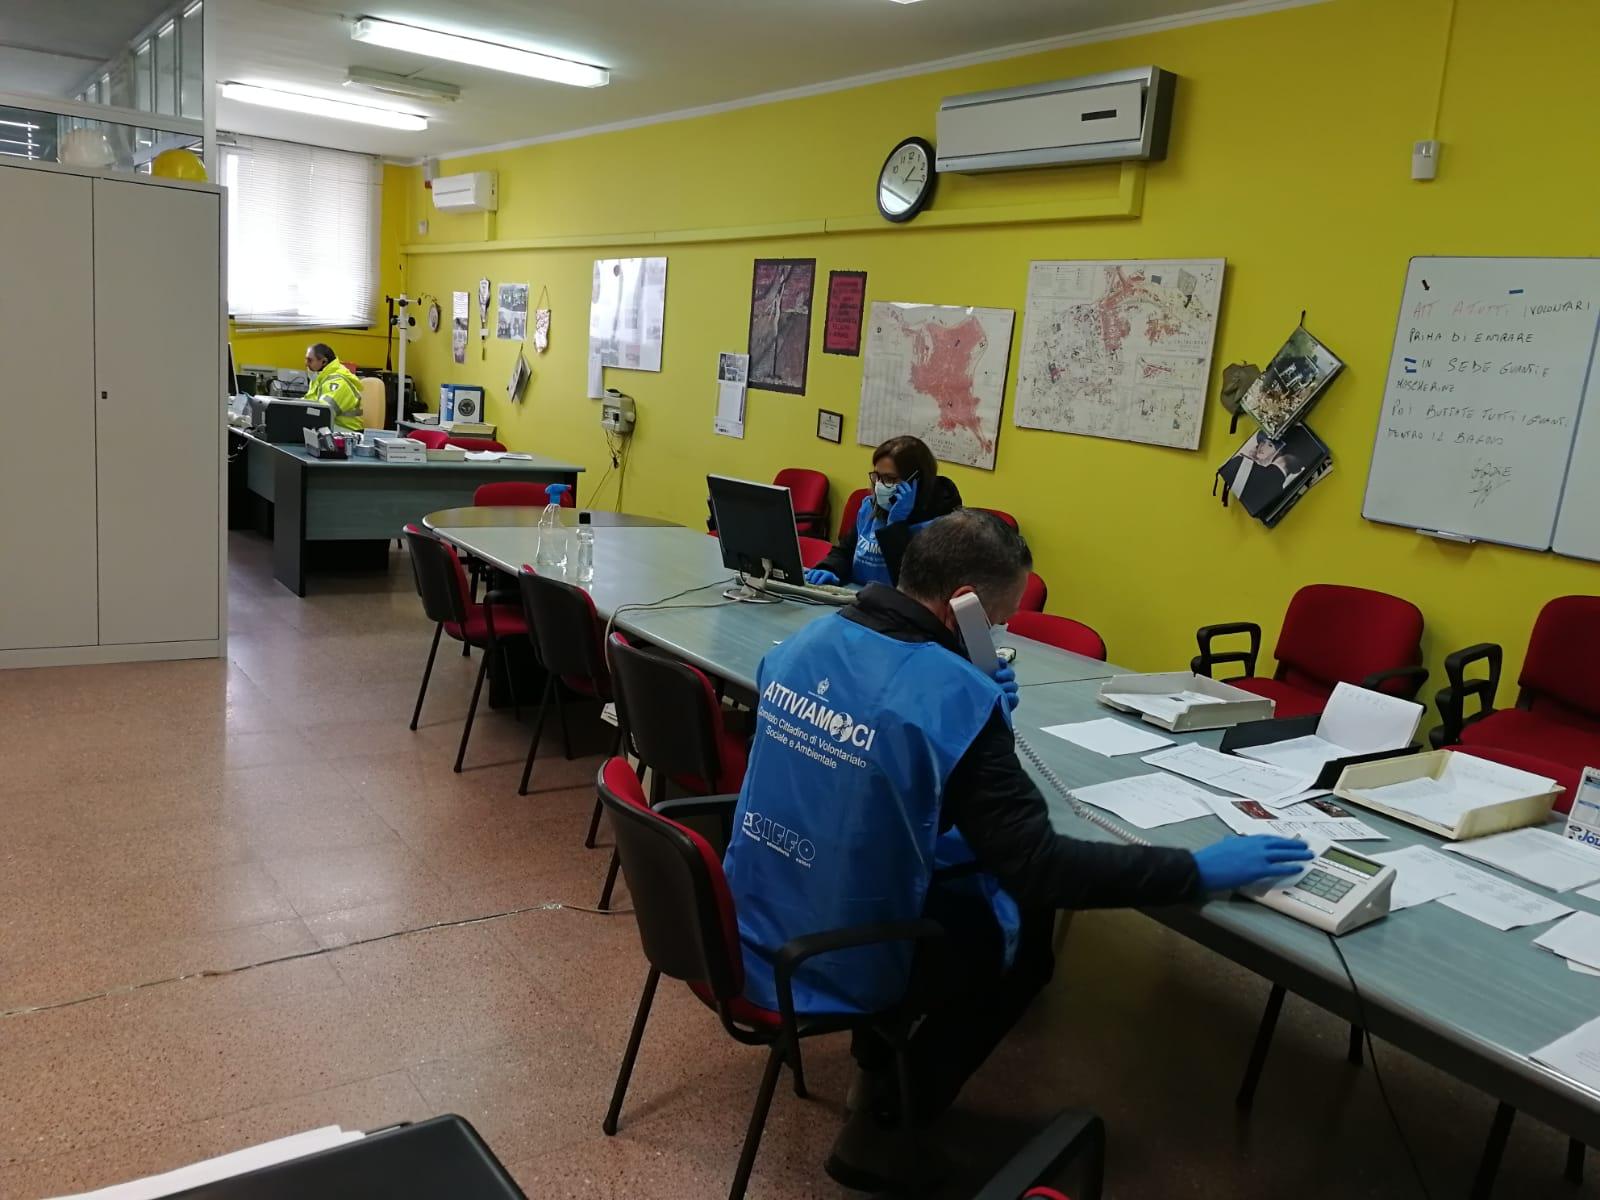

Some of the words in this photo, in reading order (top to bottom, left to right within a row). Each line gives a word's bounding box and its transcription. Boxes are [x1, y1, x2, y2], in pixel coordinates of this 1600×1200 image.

[765, 725, 789, 745] Sociale
[794, 741, 837, 769] Ambientale
[778, 718, 809, 741] Cittadino
[808, 734, 818, 744] di
[818, 737, 868, 769] Volontariato
